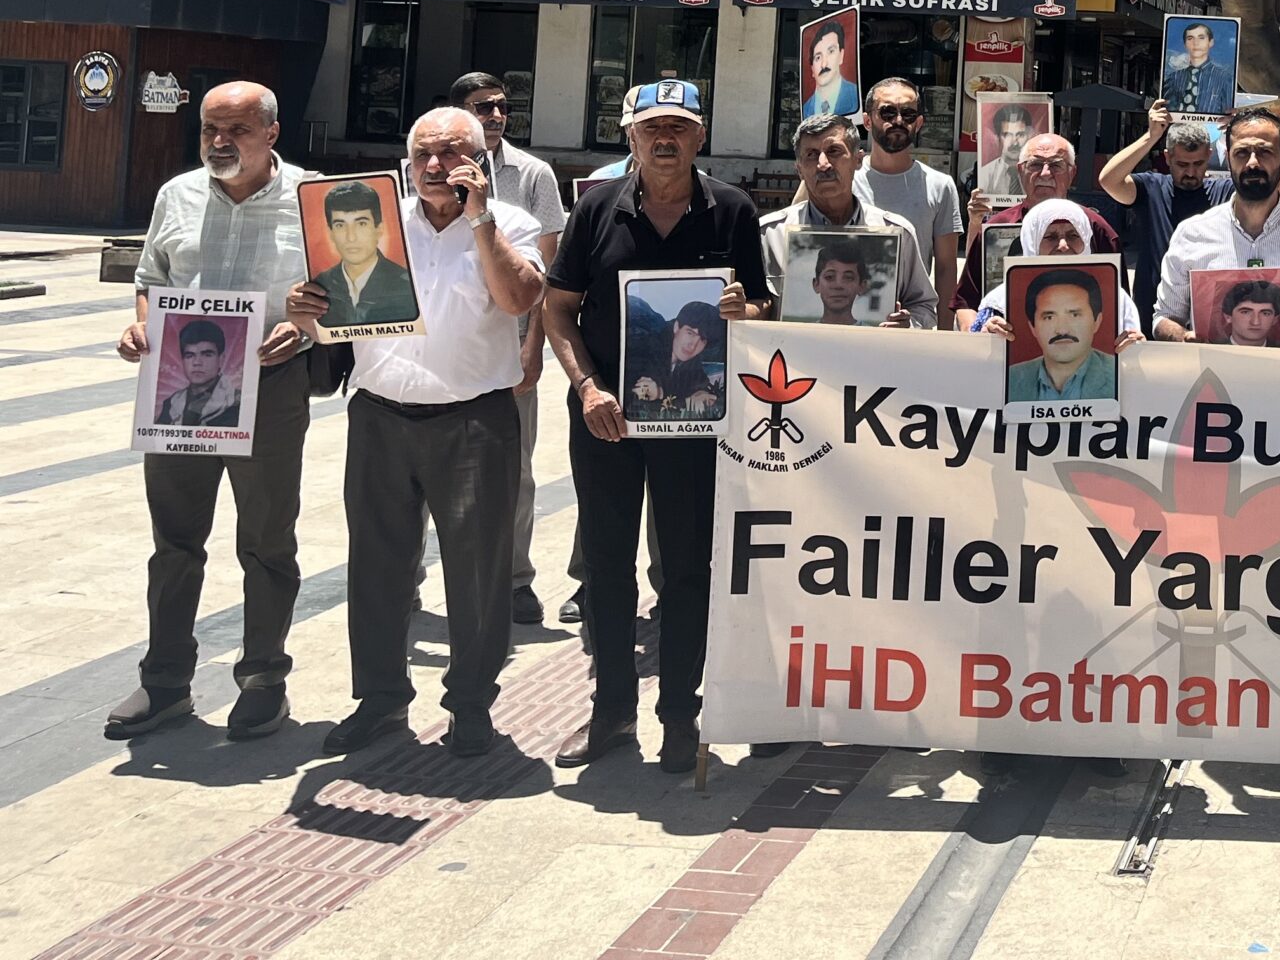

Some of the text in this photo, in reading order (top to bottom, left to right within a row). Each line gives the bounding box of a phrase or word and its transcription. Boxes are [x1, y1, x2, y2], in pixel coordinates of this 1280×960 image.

[143, 89, 180, 104] BATMAN
[158, 295, 255, 315] EDİP ÇELİK
[330, 324, 415, 339] M.ŞİRİN MALTU
[1030, 402, 1093, 419] İSA GÖK
[136, 427, 250, 440] 10/07/1993'DE GÖZALTINDA
[636, 421, 714, 433] İSMAİL AĞAYA
[843, 385, 1168, 471] Kayıplar
[166, 442, 217, 453] KAYBEDİLDİ
[717, 438, 834, 473] İNSAN HAKLARI DERNEĞİ
[765, 450, 786, 462] 1986
[730, 510, 1060, 605] Failler
[786, 625, 927, 712] İHD
[960, 653, 1272, 727] Batman
